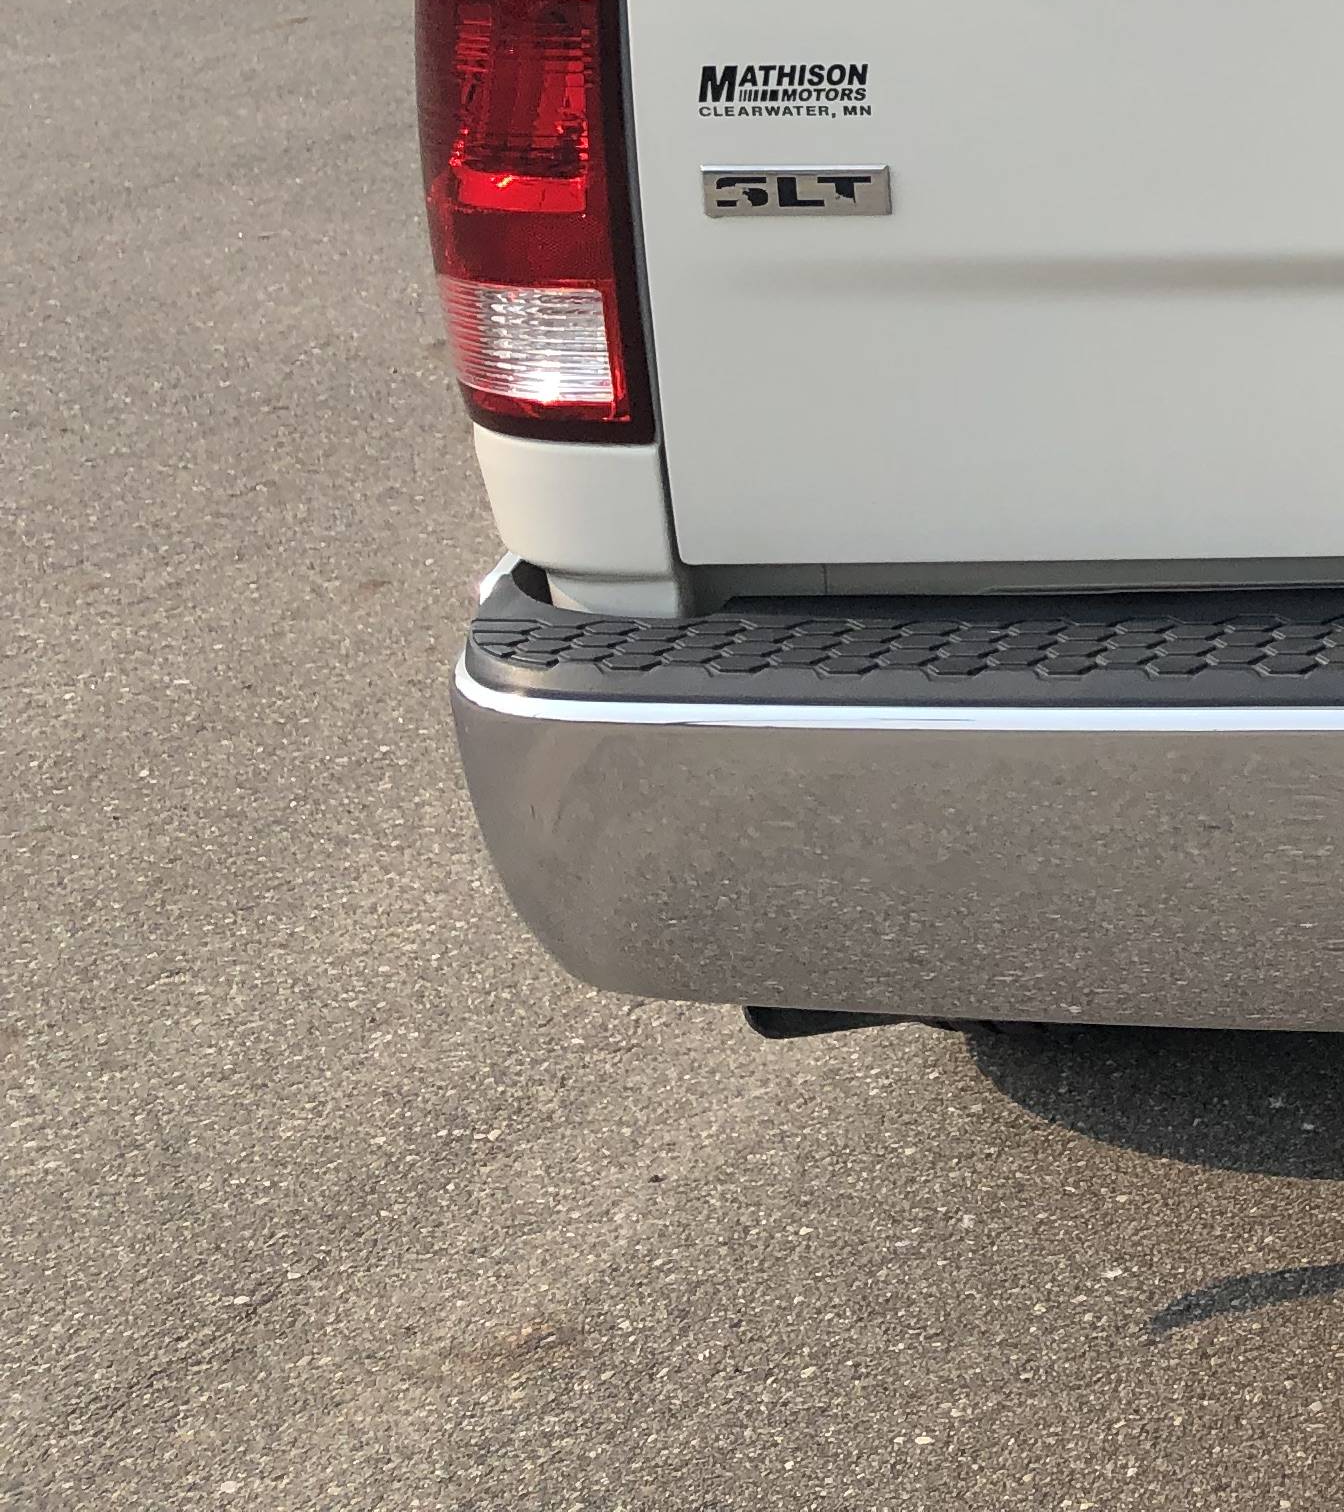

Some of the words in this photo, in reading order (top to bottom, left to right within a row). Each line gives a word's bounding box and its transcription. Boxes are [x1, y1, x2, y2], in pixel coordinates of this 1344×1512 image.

[699, 64, 868, 103] MATHISON
[781, 88, 867, 102] MOTORS
[699, 106, 837, 119] CLEARWATER,
[843, 105, 872, 117] MN
[716, 176, 871, 207] SLT
